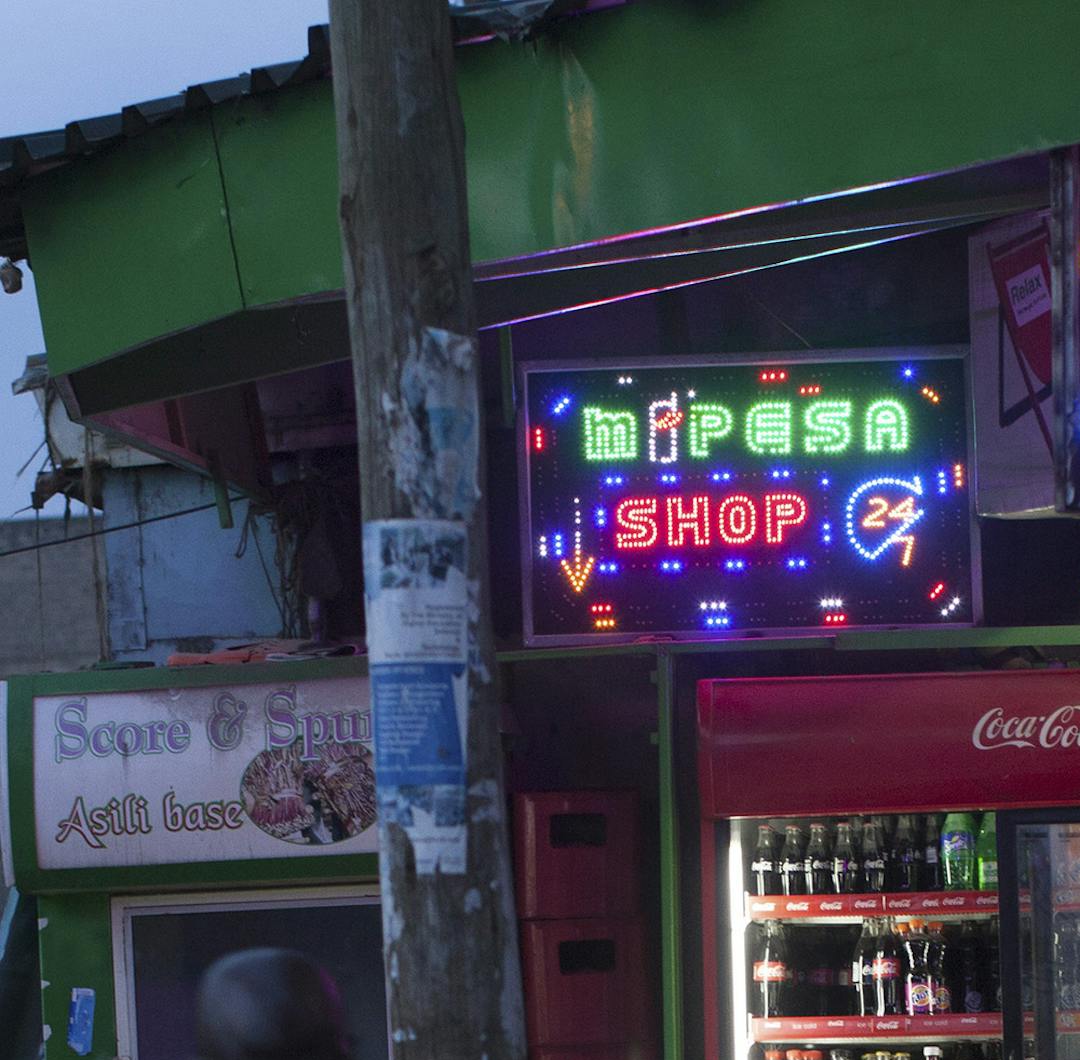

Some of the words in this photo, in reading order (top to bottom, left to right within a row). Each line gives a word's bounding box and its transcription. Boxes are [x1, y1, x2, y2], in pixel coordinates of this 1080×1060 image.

[1010, 273, 1042, 305] Relax
[615, 493, 807, 549] SHOP
[54, 697, 192, 764] Score
[206, 690, 249, 752] &
[56, 793, 152, 848] Asili
[162, 789, 246, 832] base
